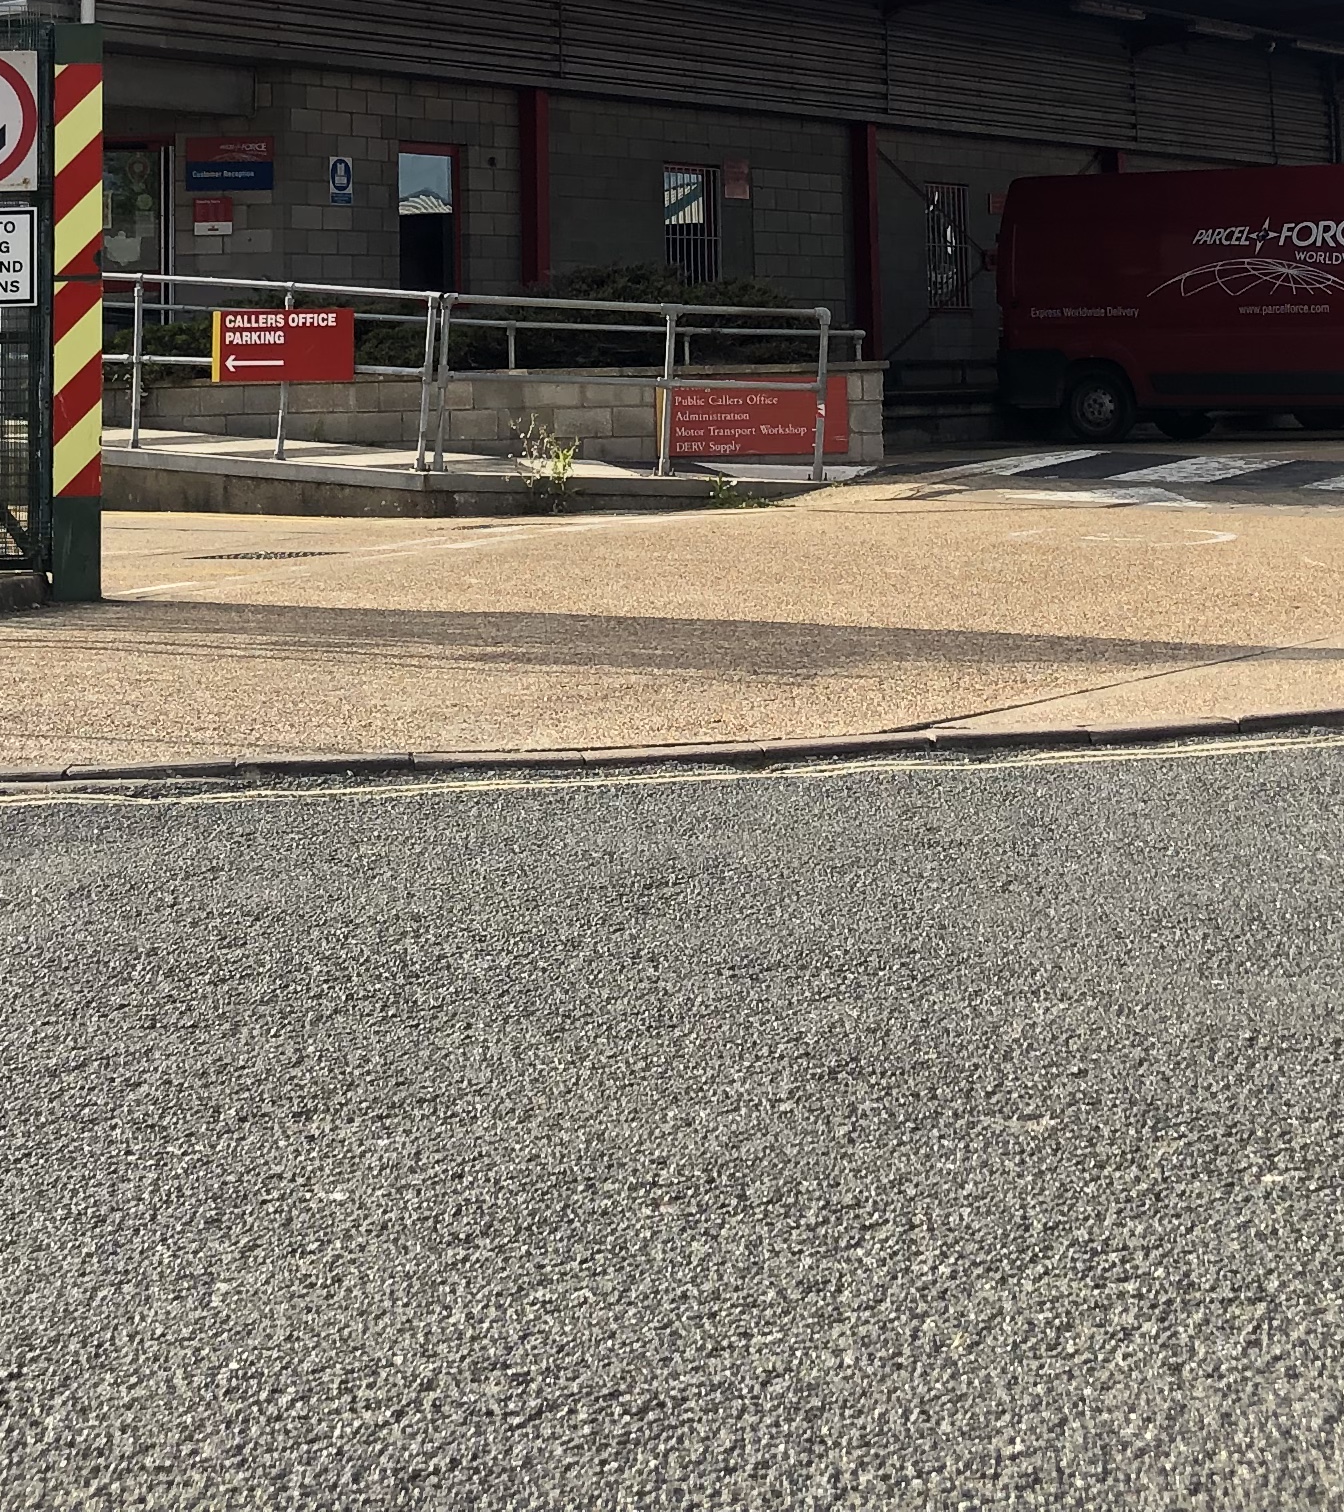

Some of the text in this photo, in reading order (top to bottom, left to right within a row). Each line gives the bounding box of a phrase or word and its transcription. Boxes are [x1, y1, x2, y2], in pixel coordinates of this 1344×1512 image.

[223, 170, 255, 178] Reception
[1192, 226, 1250, 245] PARCEL
[1031, 308, 1061, 319] Express
[1106, 307, 1139, 318] Delivery
[1238, 303, 1330, 316] www.parcelforce.com
[225, 313, 337, 328] CALLERS OFFICE
[225, 331, 285, 345] PARKING
[674, 394, 778, 406] Public Callers Office
[676, 411, 749, 421] Administration
[676, 424, 807, 437] Motor Transport Workshop
[676, 441, 741, 453] DERV Supply
